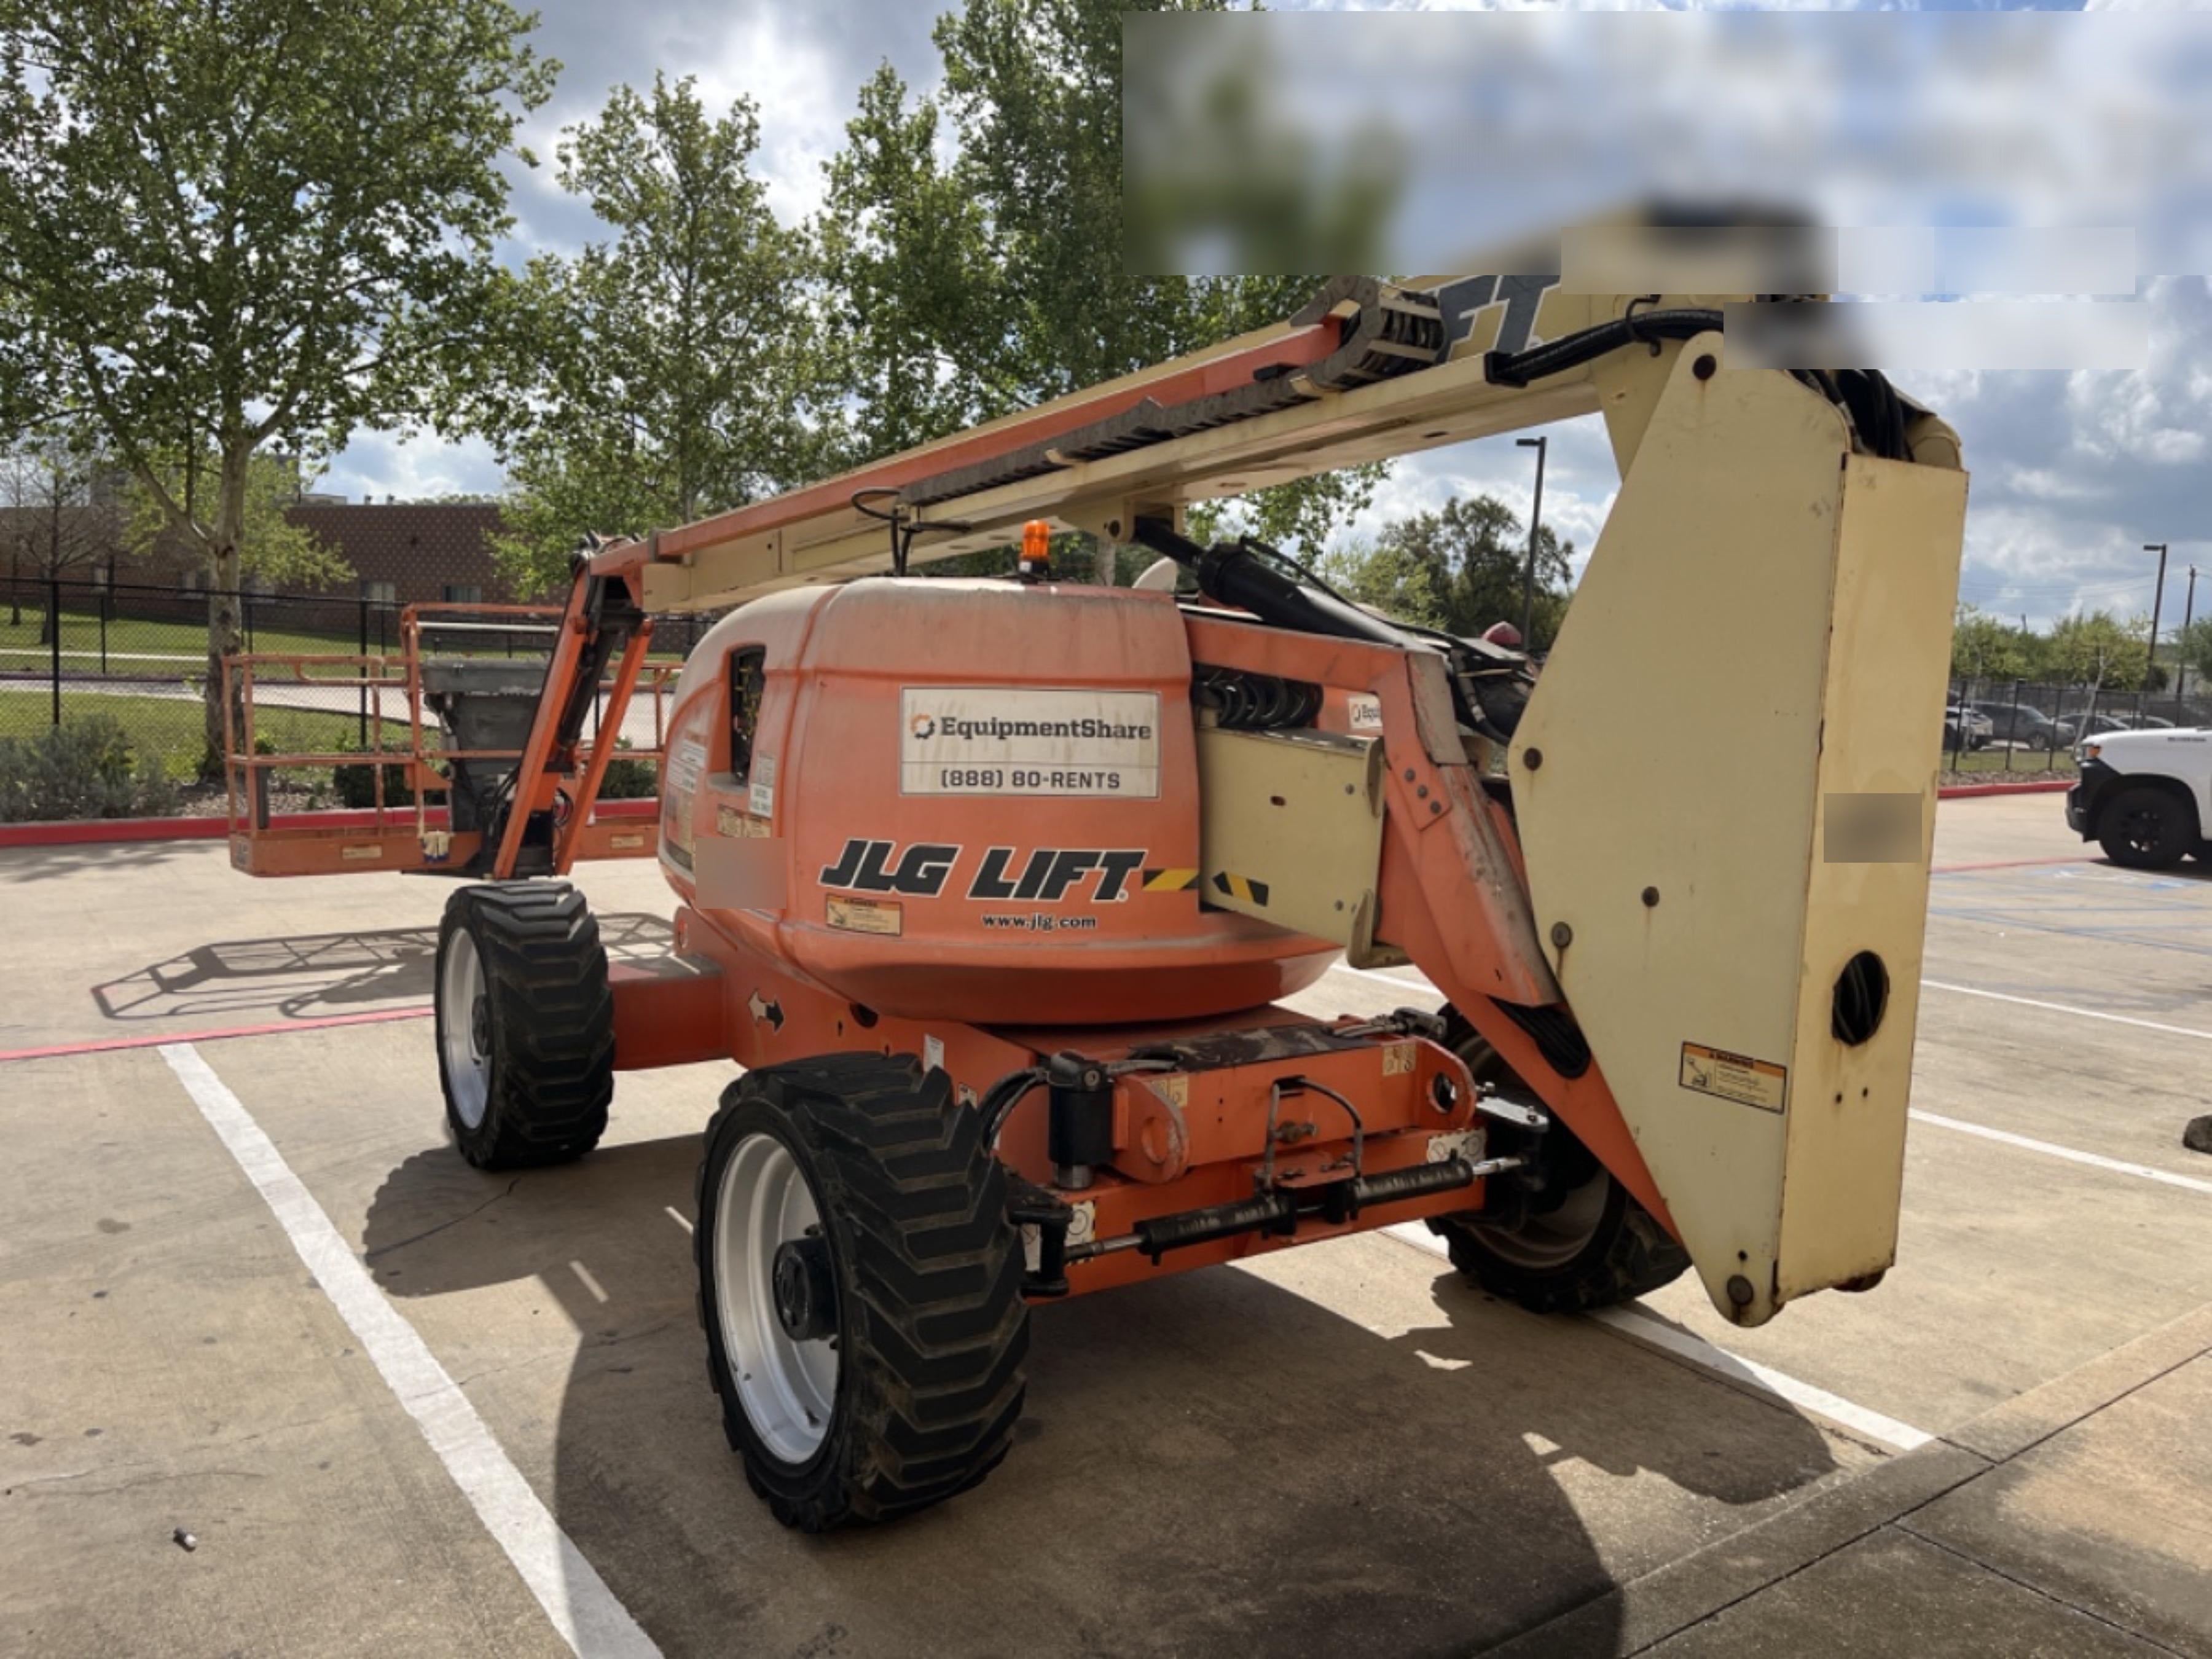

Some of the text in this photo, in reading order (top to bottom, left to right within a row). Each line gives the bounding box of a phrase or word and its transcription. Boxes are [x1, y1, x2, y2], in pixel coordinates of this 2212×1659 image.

[1424, 275, 1562, 364] FT
[941, 716, 1151, 740] EquipmentShare
[941, 769, 1121, 790] (888) 80-RENTS
[819, 839, 1147, 901] JLG LIFT
[982, 913, 1096, 932] www.jlg.com
